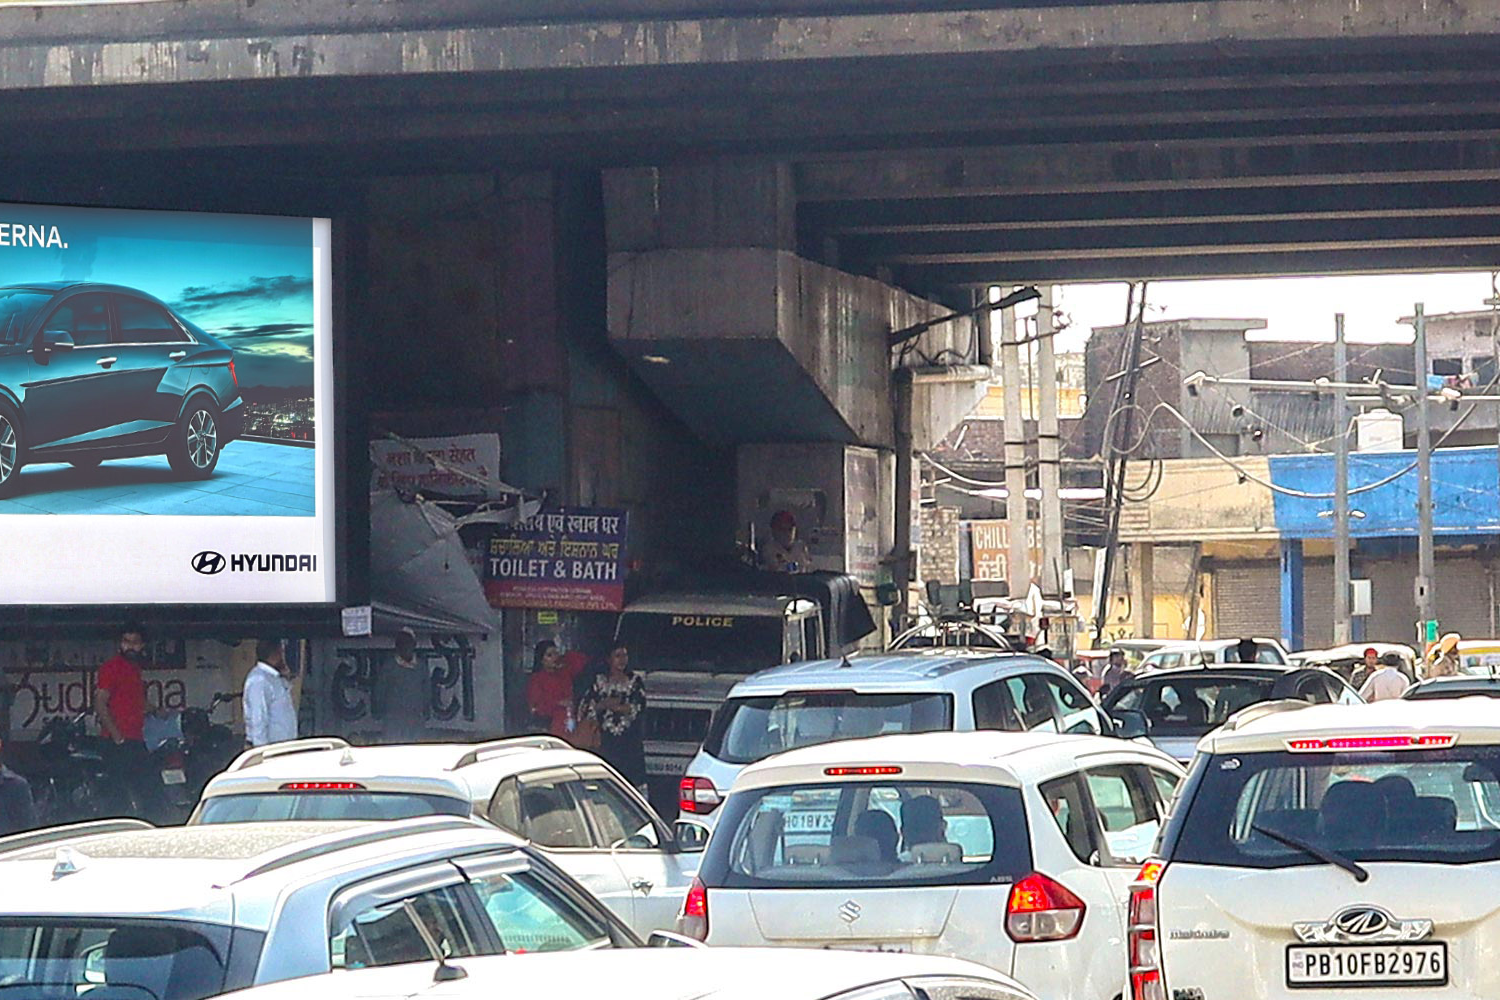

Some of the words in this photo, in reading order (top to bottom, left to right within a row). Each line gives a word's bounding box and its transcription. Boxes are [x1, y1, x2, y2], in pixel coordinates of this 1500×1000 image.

[602, 515, 620, 535] घर
[975, 525, 1011, 550] CHILL
[230, 554, 317, 573] HYUNDAI
[490, 558, 549, 577] TOILET
[554, 559, 567, 579] &
[572, 561, 617, 581] BATH
[672, 616, 734, 628] POLICE
[1305, 952, 1441, 976] PB10FB2976
